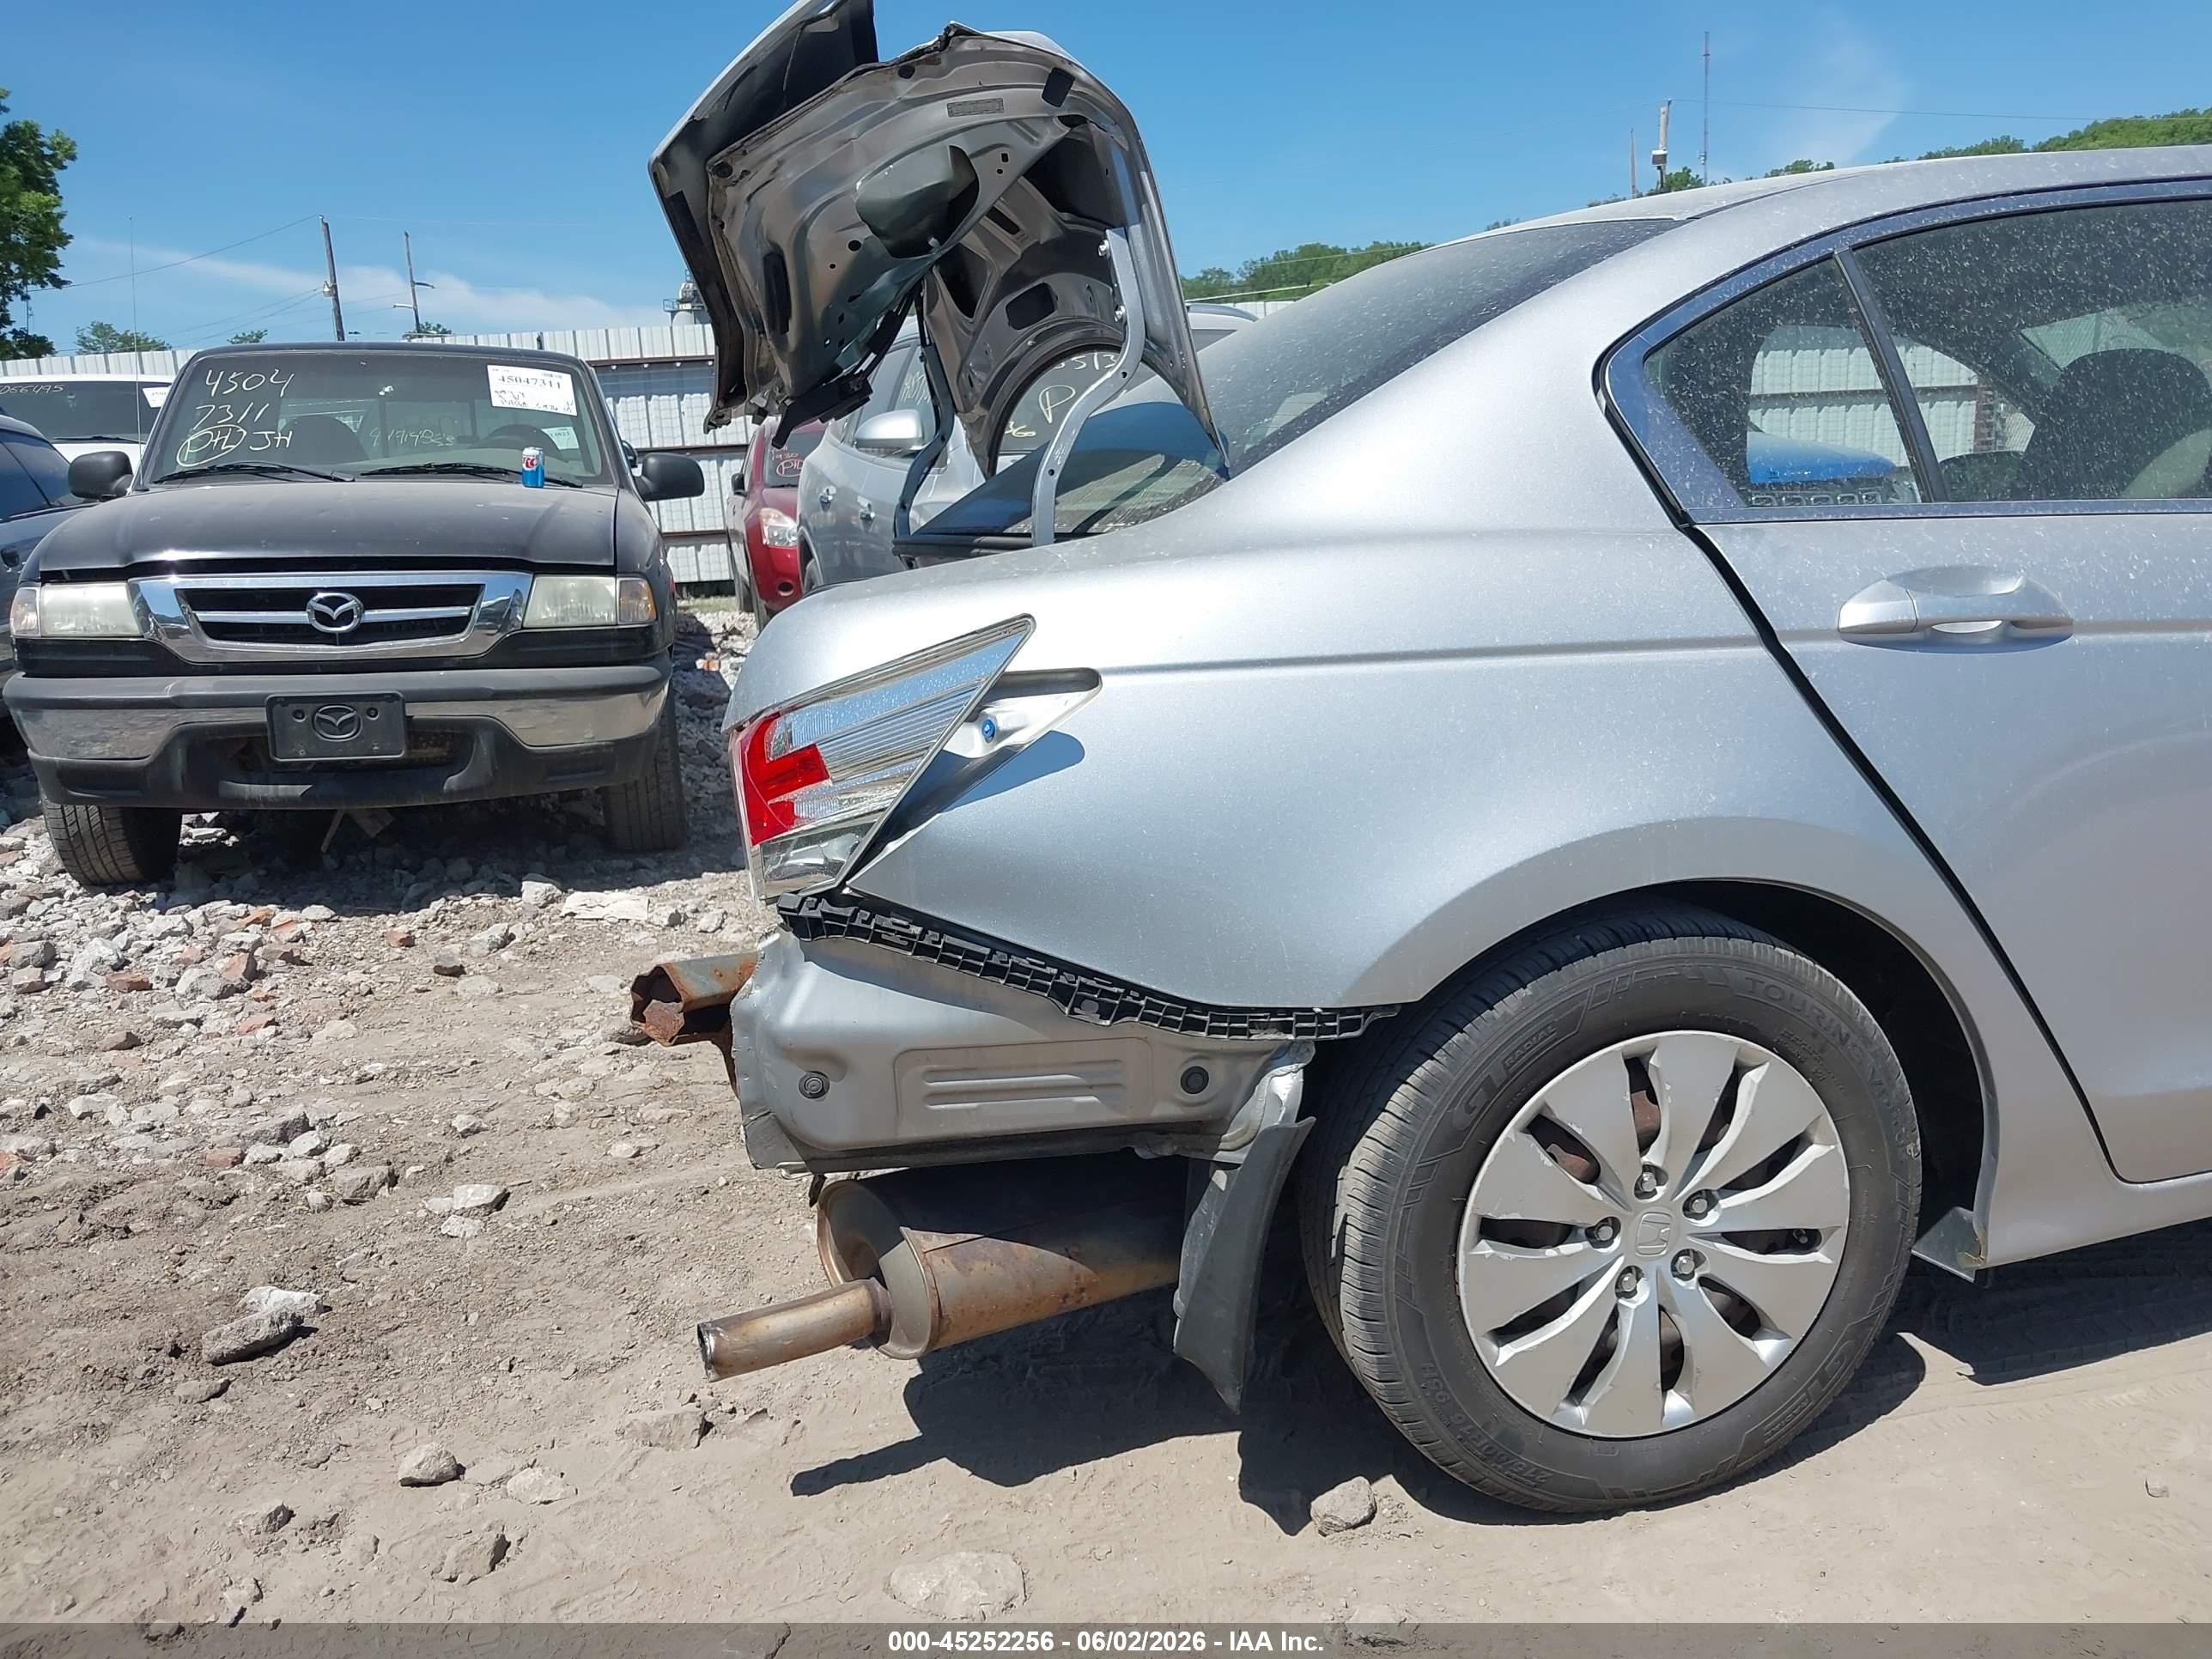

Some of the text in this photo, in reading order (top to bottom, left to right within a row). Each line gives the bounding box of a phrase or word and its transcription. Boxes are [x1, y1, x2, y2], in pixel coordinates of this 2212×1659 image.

[205, 369, 295, 398] 4504
[498, 374, 561, 389] 45047311
[193, 402, 270, 430] 7311
[249, 430, 294, 451] JH
[1744, 975, 1865, 1066] TOURING
[1504, 1025, 1558, 1067] RADIAL
